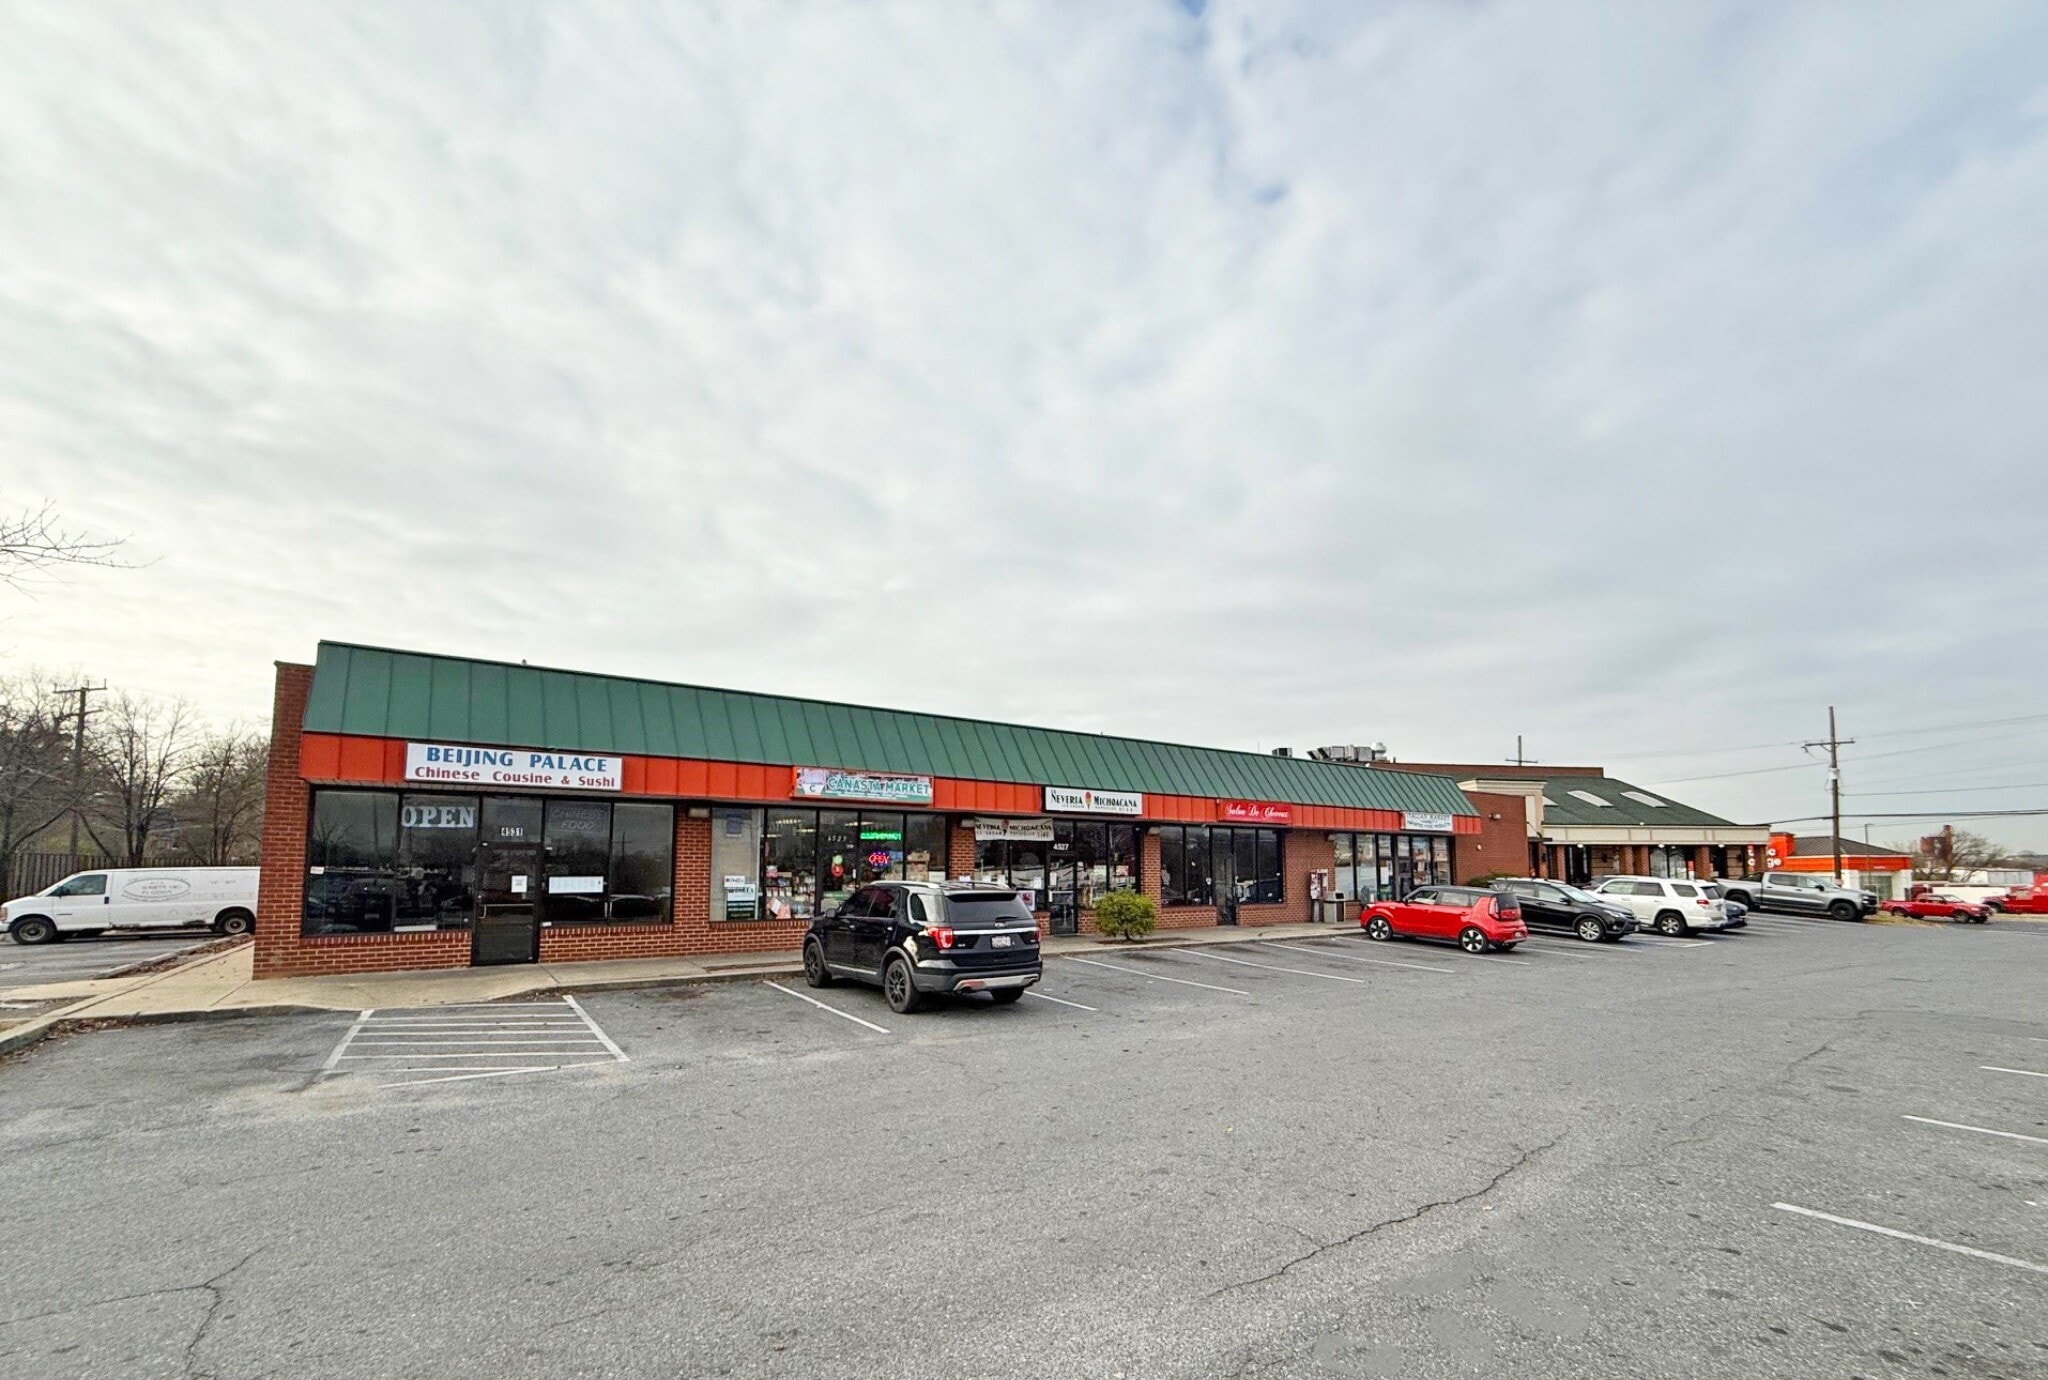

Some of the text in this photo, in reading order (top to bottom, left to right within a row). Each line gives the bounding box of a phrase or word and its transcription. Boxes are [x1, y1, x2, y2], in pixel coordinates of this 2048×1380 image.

[427, 746, 607, 772] BEIJING PALACE
[415, 766, 615, 787] Chinese Cousine & Sushi
[827, 776, 930, 794] CANASTA MARKET
[1051, 792, 1137, 807] NEVERIA MICHOACANA
[401, 805, 476, 828] OPEN
[551, 807, 605, 818] CHINESE
[869, 854, 889, 864] OPEN
